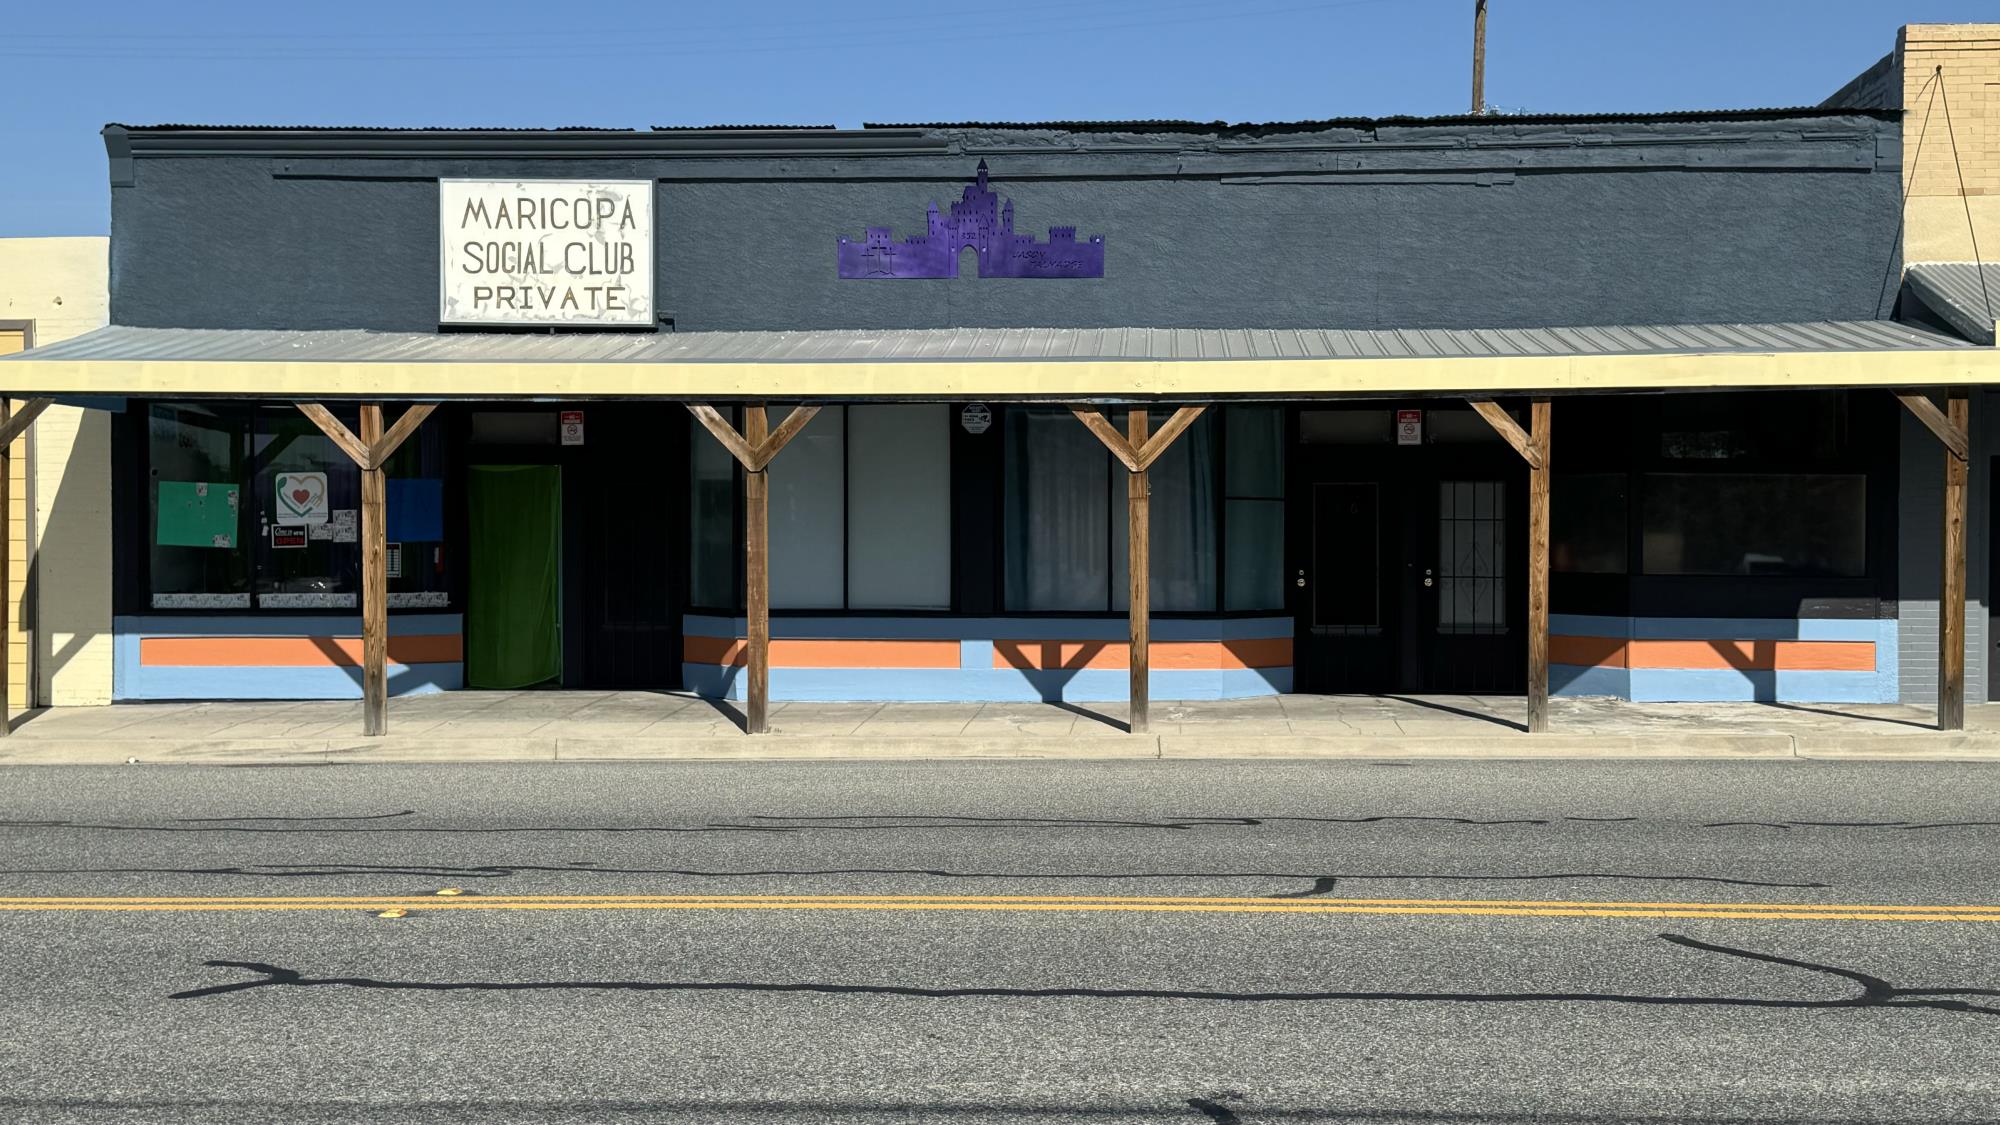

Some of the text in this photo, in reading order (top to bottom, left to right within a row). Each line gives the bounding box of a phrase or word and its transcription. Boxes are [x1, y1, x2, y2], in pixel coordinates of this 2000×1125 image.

[461, 197, 636, 230] MARICOPA
[462, 241, 635, 275] SOCIAL CLUB
[473, 286, 626, 310] PRIVATE
[275, 537, 304, 545] OPEN
